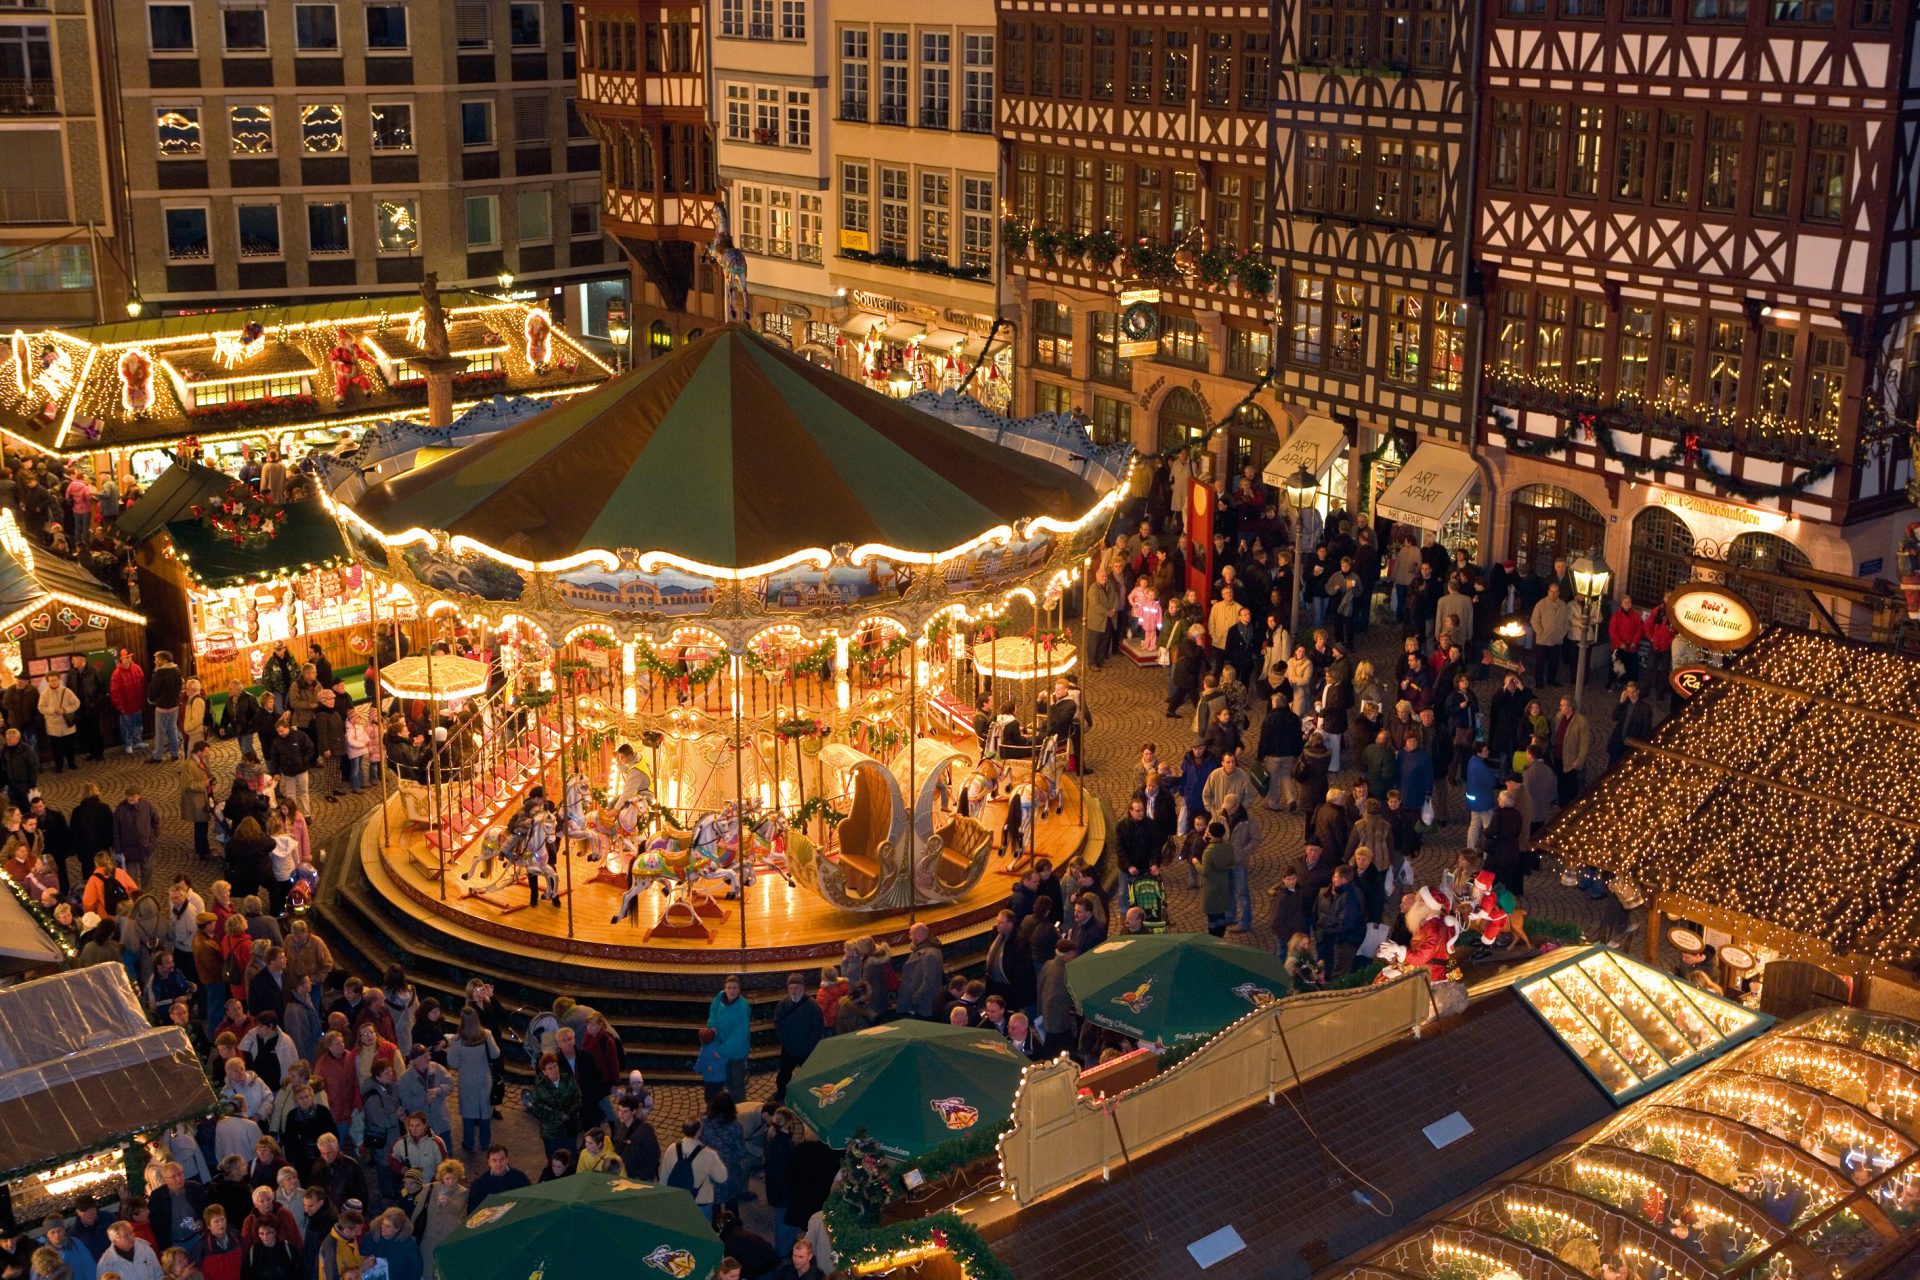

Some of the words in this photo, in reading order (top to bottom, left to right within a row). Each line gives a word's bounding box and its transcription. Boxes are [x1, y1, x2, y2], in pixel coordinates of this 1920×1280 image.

[853, 290, 906, 313] Souvenirs
[1288, 440, 1316, 453] ART
[1278, 452, 1316, 468] APART
[1267, 475, 1279, 485] ART
[1411, 470, 1439, 485] ART
[1400, 485, 1442, 503] APART
[1659, 490, 1682, 508] Zum
[1388, 509, 1400, 519] ART
[1402, 513, 1425, 526] APART
[1684, 610, 1743, 632] Kaffee-Scheune
[1094, 1013, 1113, 1028] Merry
[1113, 1019, 1144, 1036] Christmas
